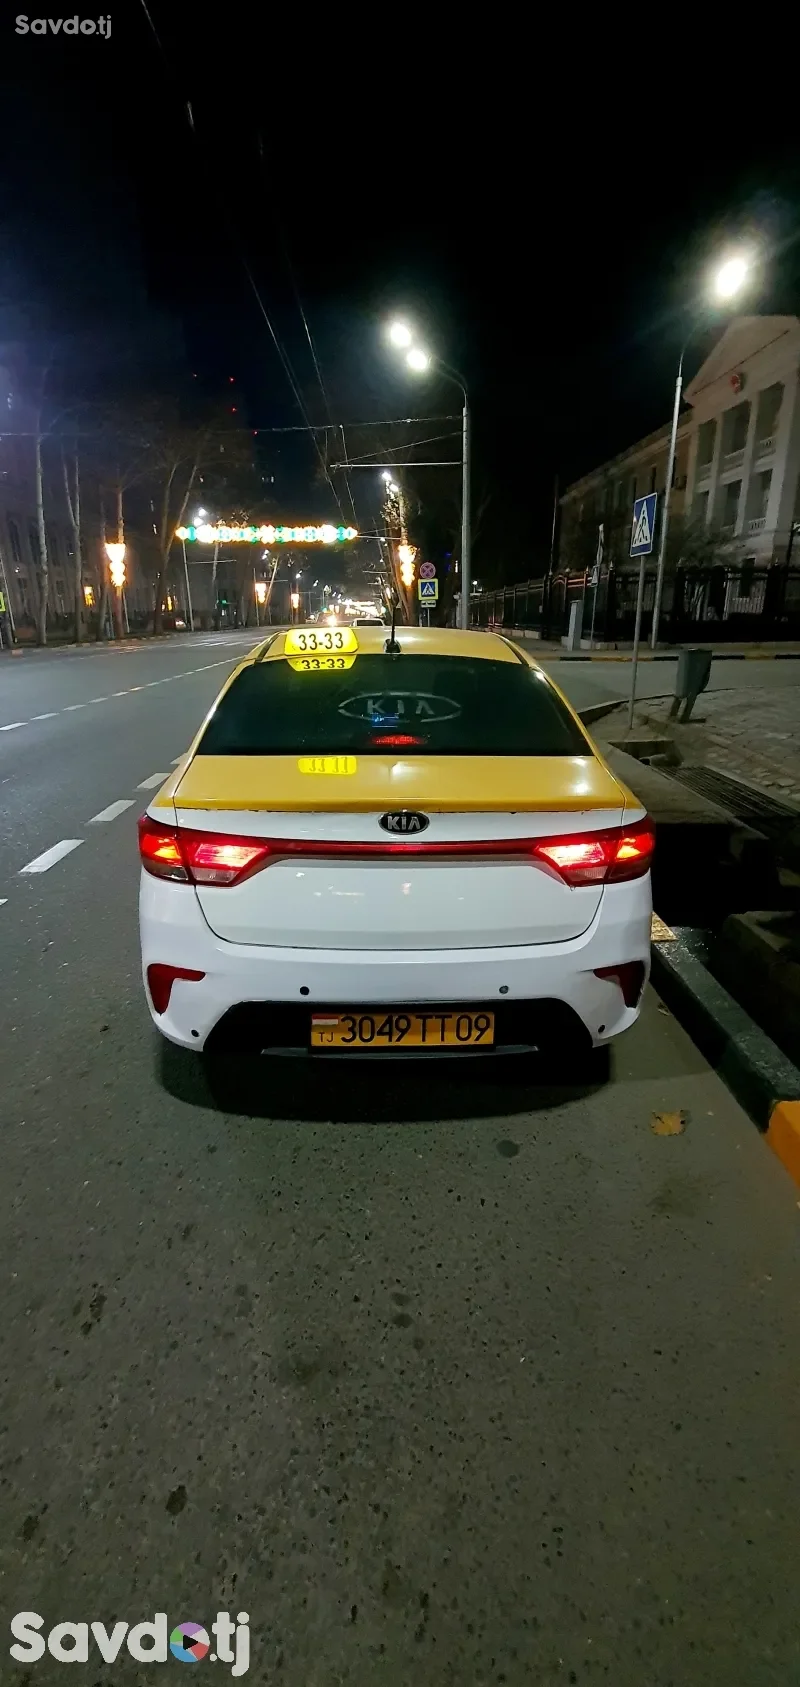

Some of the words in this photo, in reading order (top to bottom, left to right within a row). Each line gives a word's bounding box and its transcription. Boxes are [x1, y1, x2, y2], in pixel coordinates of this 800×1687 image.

[298, 632, 344, 651] 33-33
[367, 699, 434, 714] KIA
[387, 815, 420, 830] KIA
[318, 1031, 334, 1043] TJ
